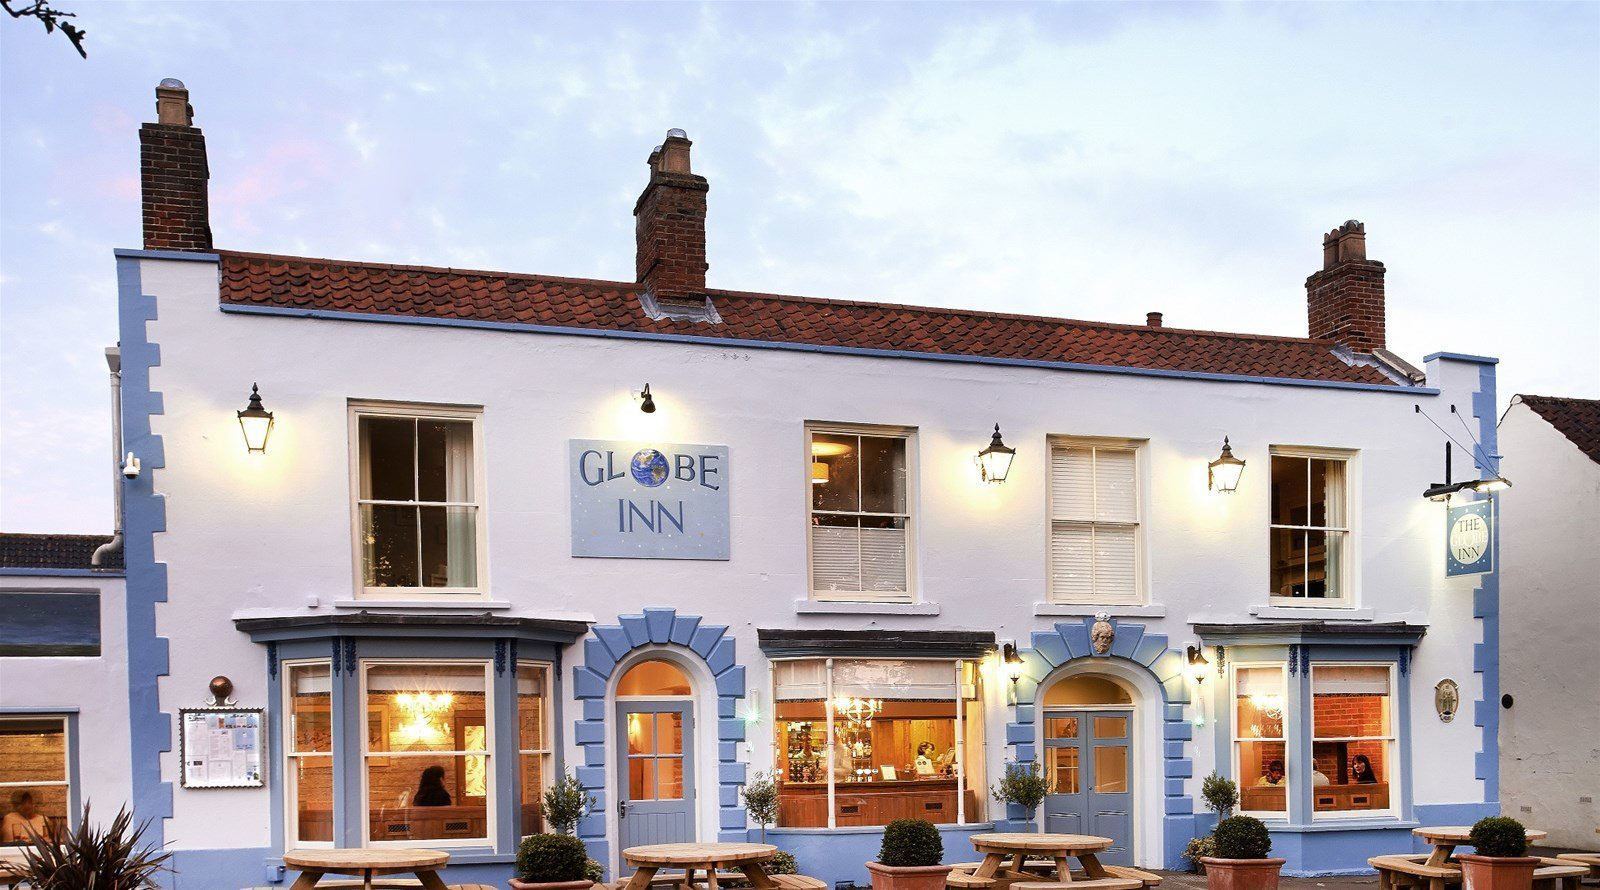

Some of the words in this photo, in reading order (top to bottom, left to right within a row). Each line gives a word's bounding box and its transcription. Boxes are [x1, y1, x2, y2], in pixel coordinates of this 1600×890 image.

[618, 498, 684, 534] INN
[1458, 517, 1481, 532] THE
[1458, 546, 1480, 560] INN
